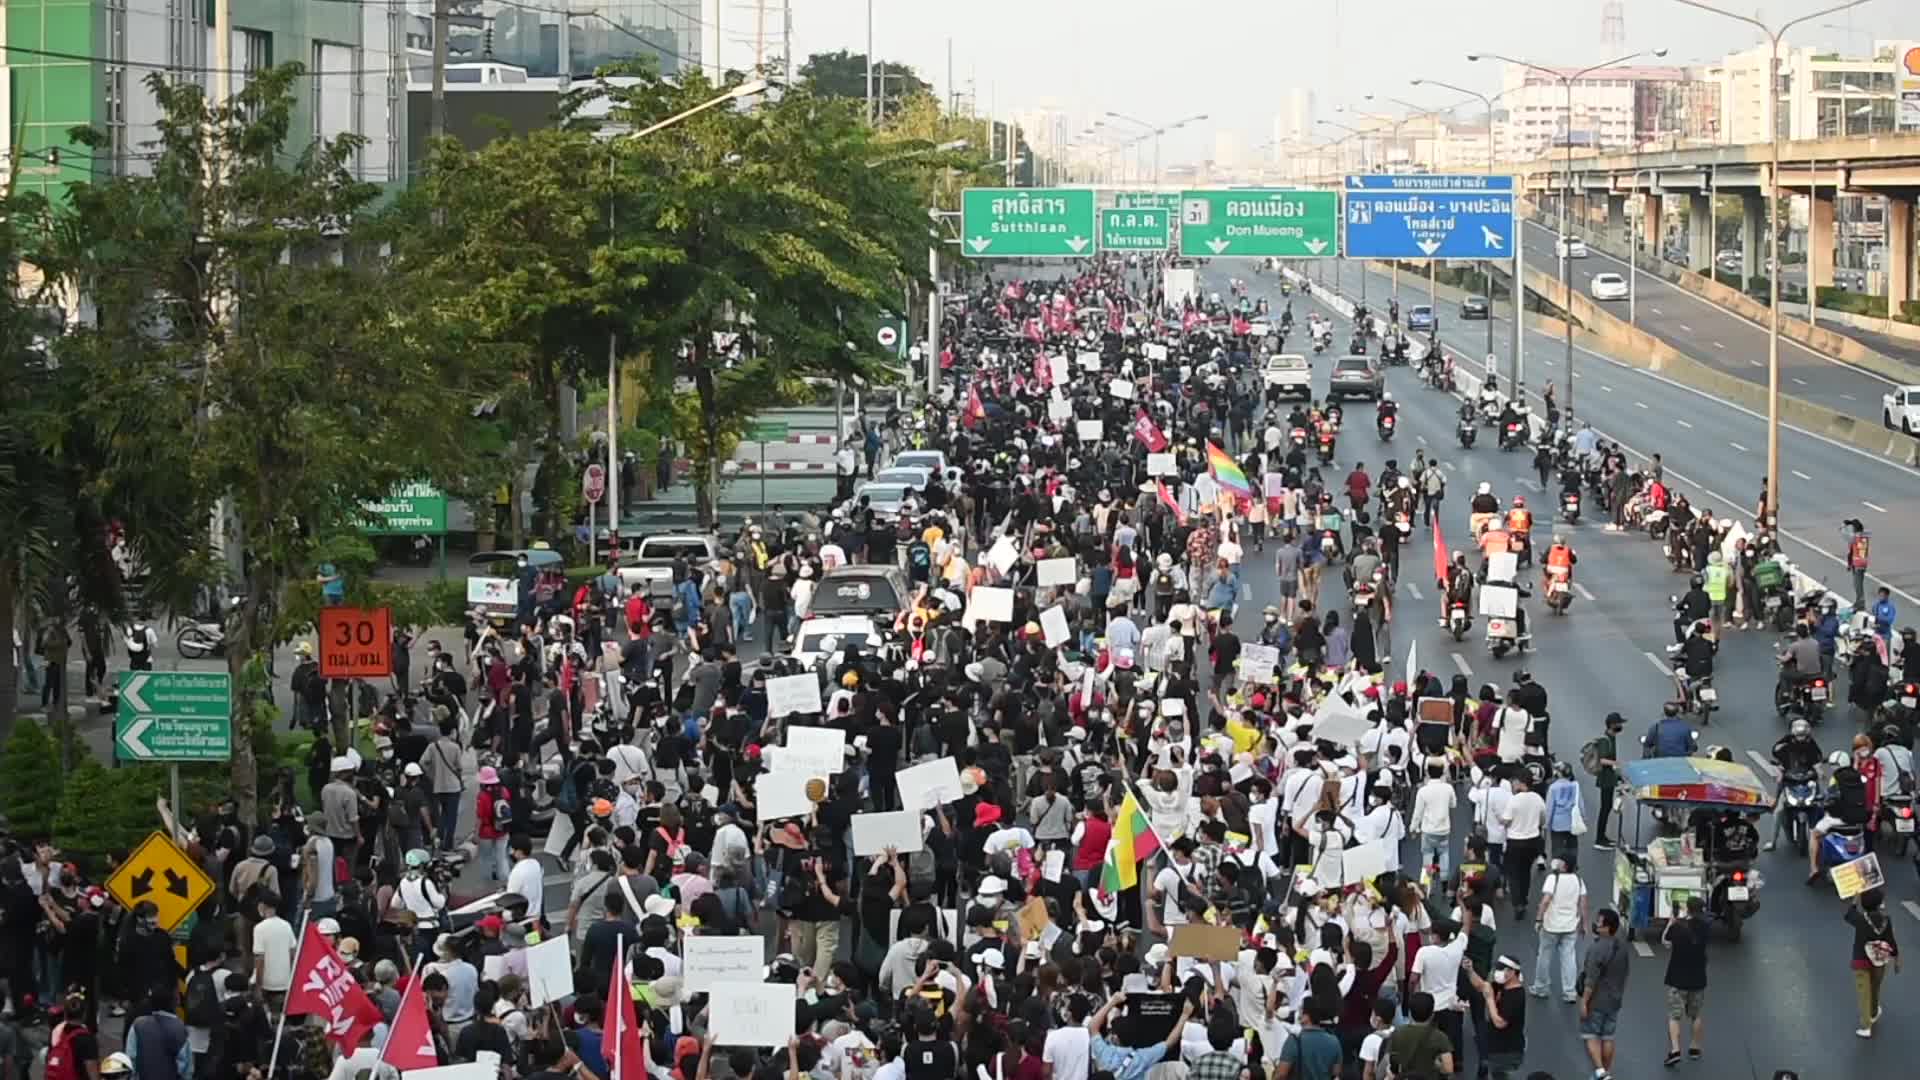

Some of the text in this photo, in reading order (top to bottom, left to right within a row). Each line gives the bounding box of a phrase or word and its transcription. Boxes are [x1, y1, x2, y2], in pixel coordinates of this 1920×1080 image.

[991, 191, 1065, 220] สุทธิสาร
[1226, 193, 1304, 217] ดอนเมือง
[1374, 196, 1434, 213] ดอนเมือง
[1450, 198, 1512, 213] บางปะอิน
[991, 221, 1067, 233] Sutthisan
[1226, 224, 1303, 238] Don Mueang
[335, 621, 374, 647] 30
